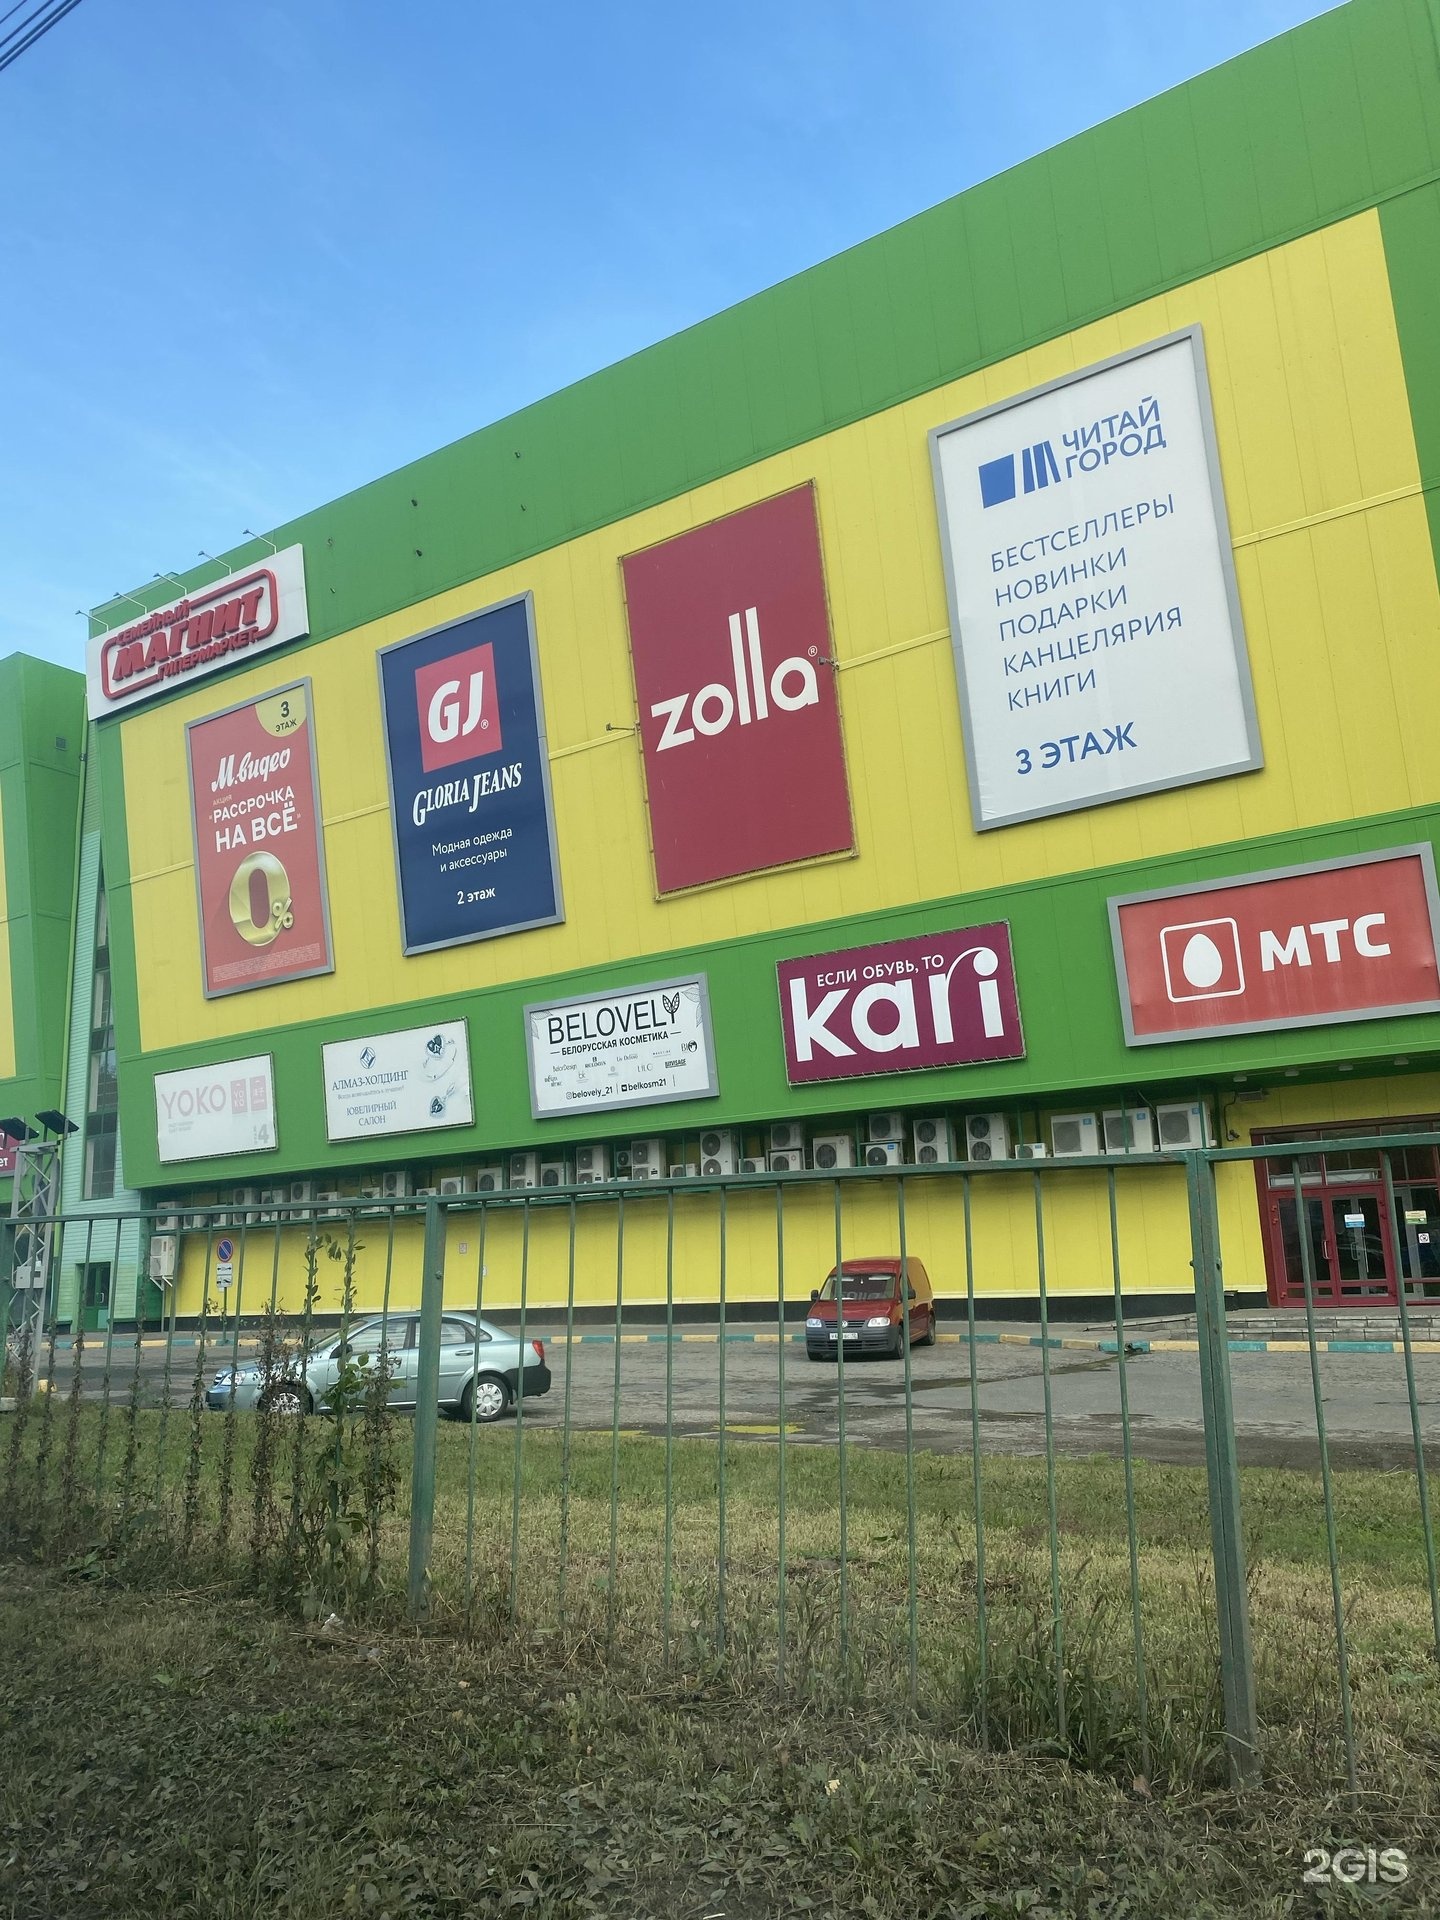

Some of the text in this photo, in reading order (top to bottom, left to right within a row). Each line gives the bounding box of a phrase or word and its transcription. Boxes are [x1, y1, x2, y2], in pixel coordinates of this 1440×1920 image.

[1062, 395, 1161, 452] ЧИТАЙ
[1065, 423, 1166, 478] ГОРОД
[990, 493, 1174, 573] БЕСТСЕЛЛЕРЫ
[995, 547, 1127, 607] НОВИНКИ
[112, 586, 264, 681] МАГНИТ
[115, 599, 191, 646] СЕМЕЙНЫЙ
[999, 585, 1127, 642] ПОДАРКИ
[157, 626, 259, 681] ГИПЕРМАРКЕТ
[1003, 606, 1183, 677] КАНЦЕЛЯРИЯ
[650, 606, 819, 752] zolla
[1008, 668, 1096, 712] КНИГИ
[275, 718, 297, 732] ЭТАЖ
[280, 700, 290, 718] 3
[1015, 721, 1138, 775] 3 ЭТАЖ
[412, 762, 522, 827] GLORIA JEANS
[215, 824, 247, 853] НА
[432, 827, 513, 856] Модная одежда
[440, 848, 508, 873] и аксессуары
[456, 887, 496, 905] 2 этаж
[1259, 912, 1392, 972] МТС
[816, 954, 945, 987] ЕСЛИ ОБУВЬ, ТО
[547, 992, 680, 1045] BELOVELY
[789, 946, 1005, 1063] kari
[561, 1030, 669, 1056] БЕЛОРУССКАЯ КОСМЕТИКА
[161, 1084, 226, 1120] YOKO
[332, 1070, 409, 1091] АЛМАЗ-ХОЛДИНГ
[628, 1078, 667, 1091] belkosm21
[346, 1100, 397, 1116] ЮВЕЛИРНЫЙ
[358, 1115, 386, 1126] САЛОН
